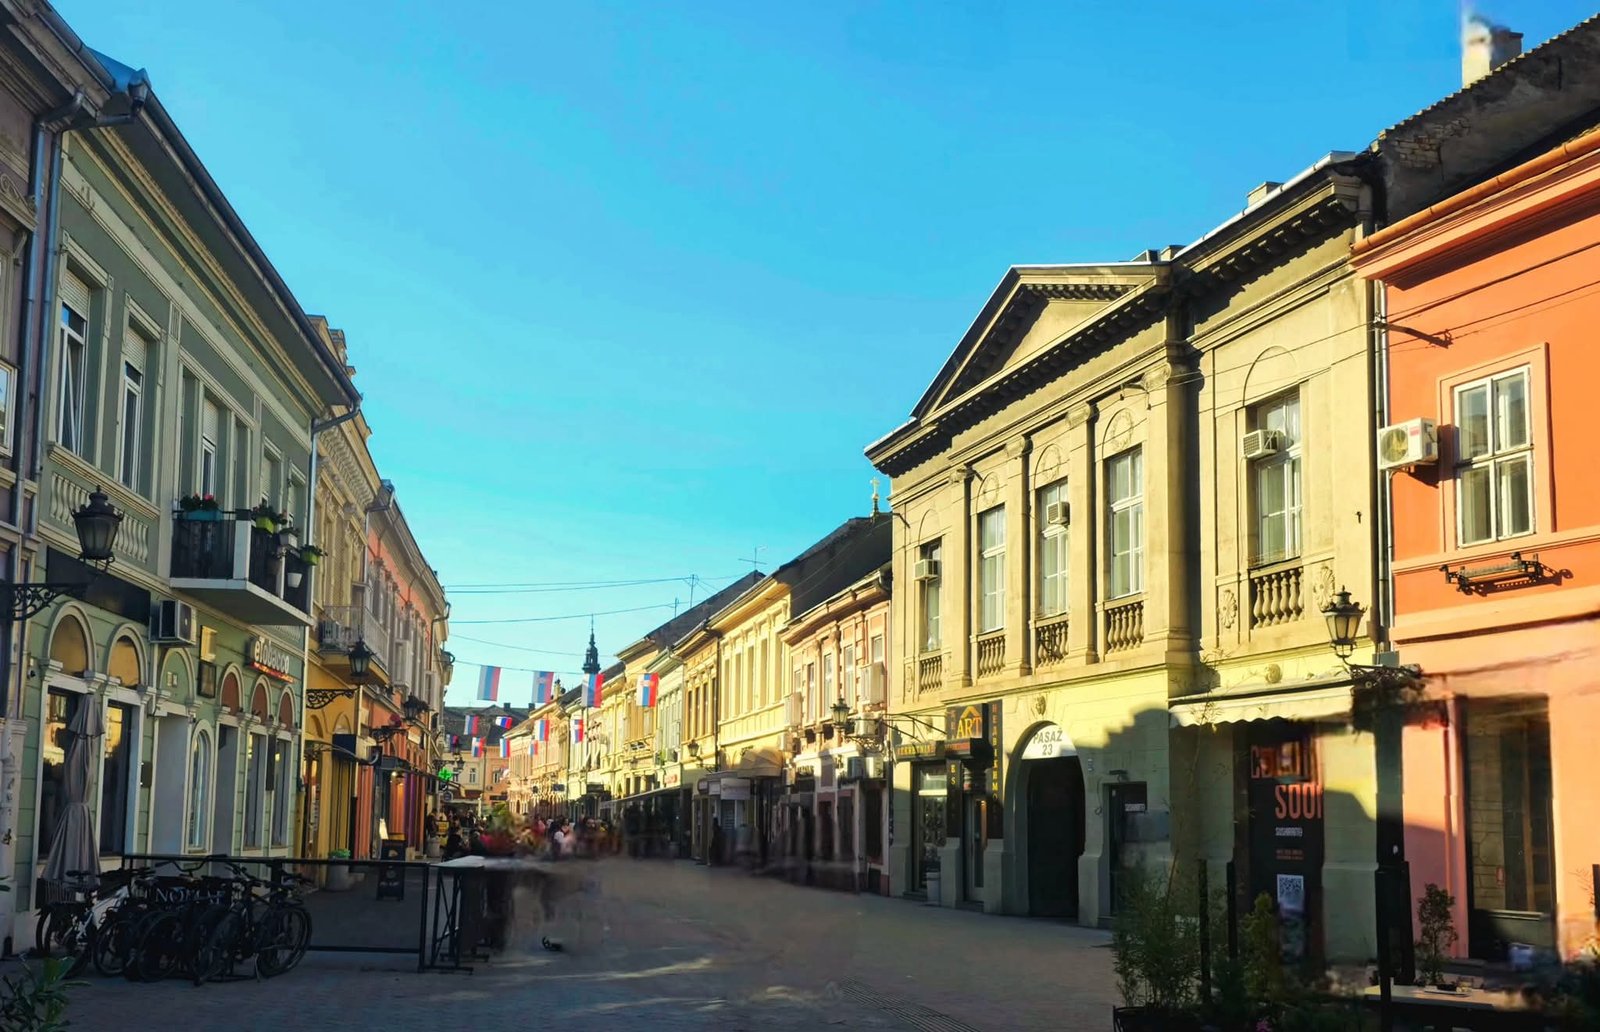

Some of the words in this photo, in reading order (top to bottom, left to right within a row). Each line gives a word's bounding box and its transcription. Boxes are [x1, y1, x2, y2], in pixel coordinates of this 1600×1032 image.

[956, 717, 982, 738] ART
[1032, 728, 1062, 744] PASAŽ
[1042, 744, 1053, 756] 23
